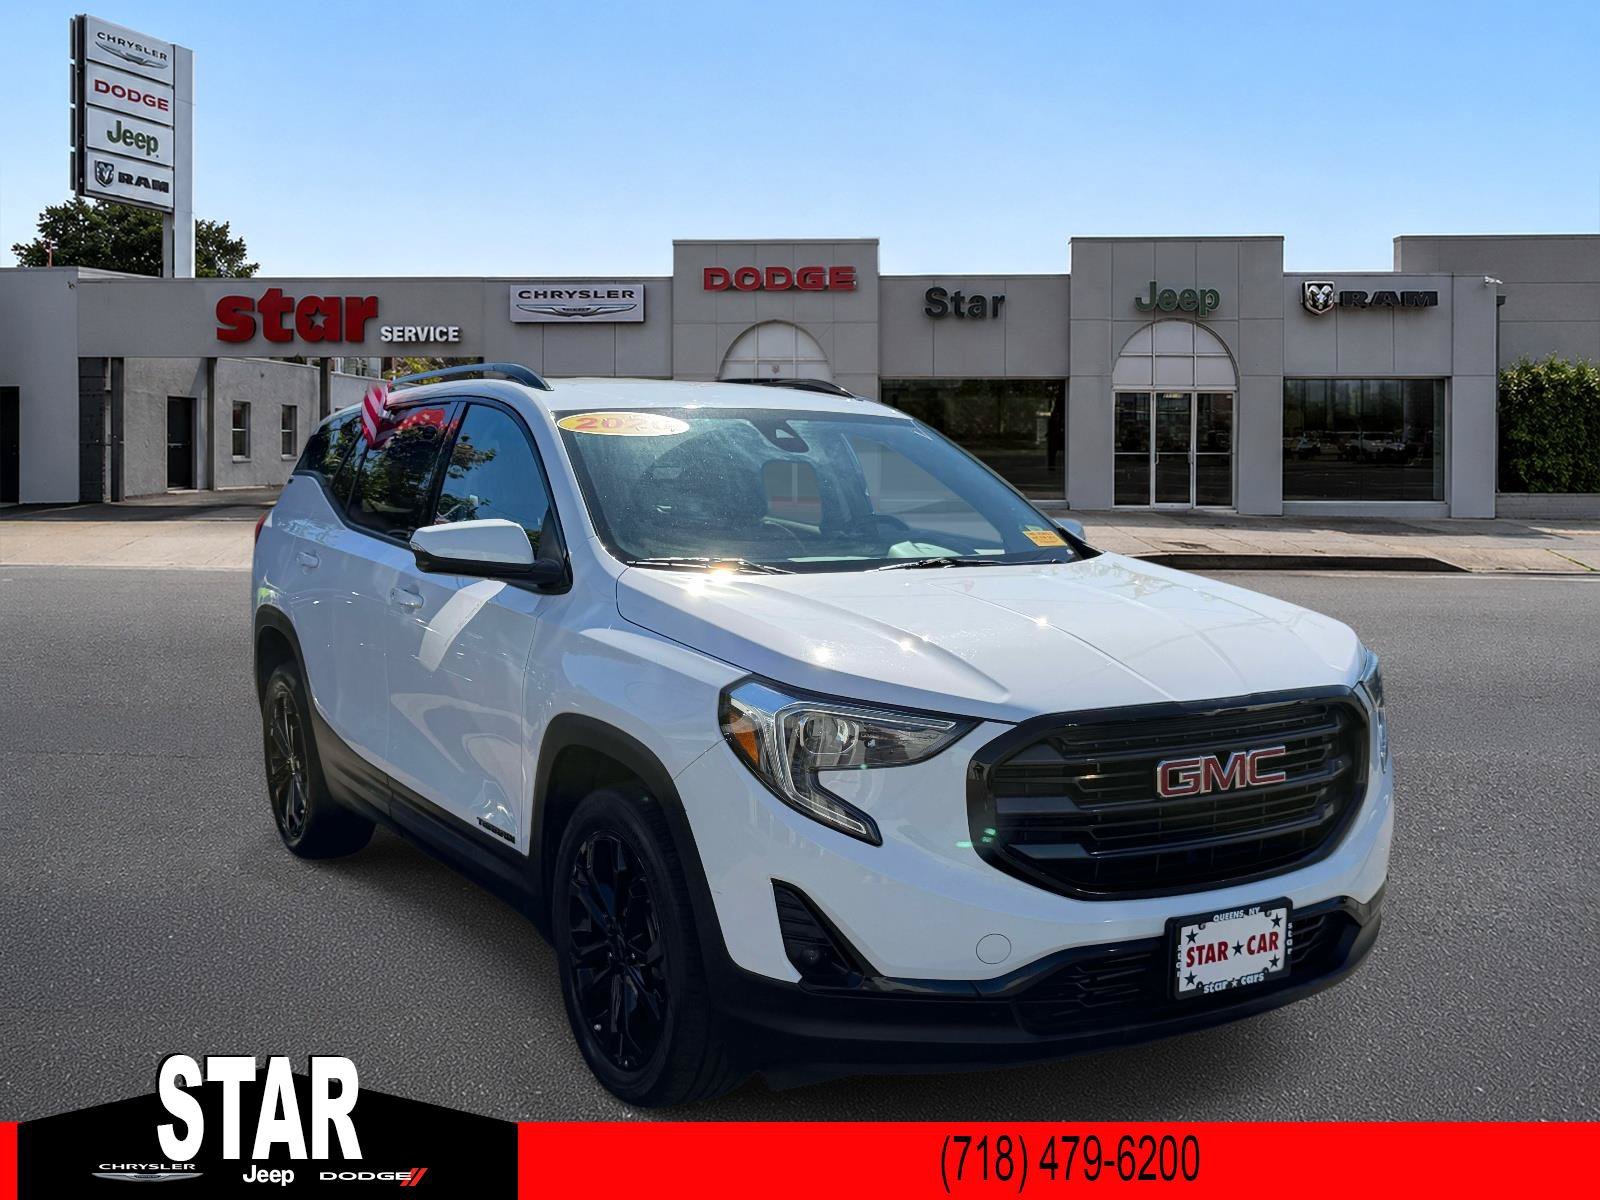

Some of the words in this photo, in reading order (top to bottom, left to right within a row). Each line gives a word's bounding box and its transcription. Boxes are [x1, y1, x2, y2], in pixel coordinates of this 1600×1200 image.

[97, 31, 168, 61] CHRYSLER
[94, 79, 169, 111] DODGE
[106, 120, 159, 157] Jeep
[118, 171, 169, 193] RAM
[518, 289, 635, 300] CHRYSLER
[703, 266, 857, 292] DODGE
[923, 286, 1006, 319] Star
[1135, 281, 1220, 317] Jeep
[1339, 290, 1438, 307] RAM
[216, 288, 378, 343] star
[379, 326, 461, 343] SERVICE
[1156, 745, 1287, 798] GMC
[1186, 941, 1229, 968] STAR
[1246, 931, 1279, 955] CAR
